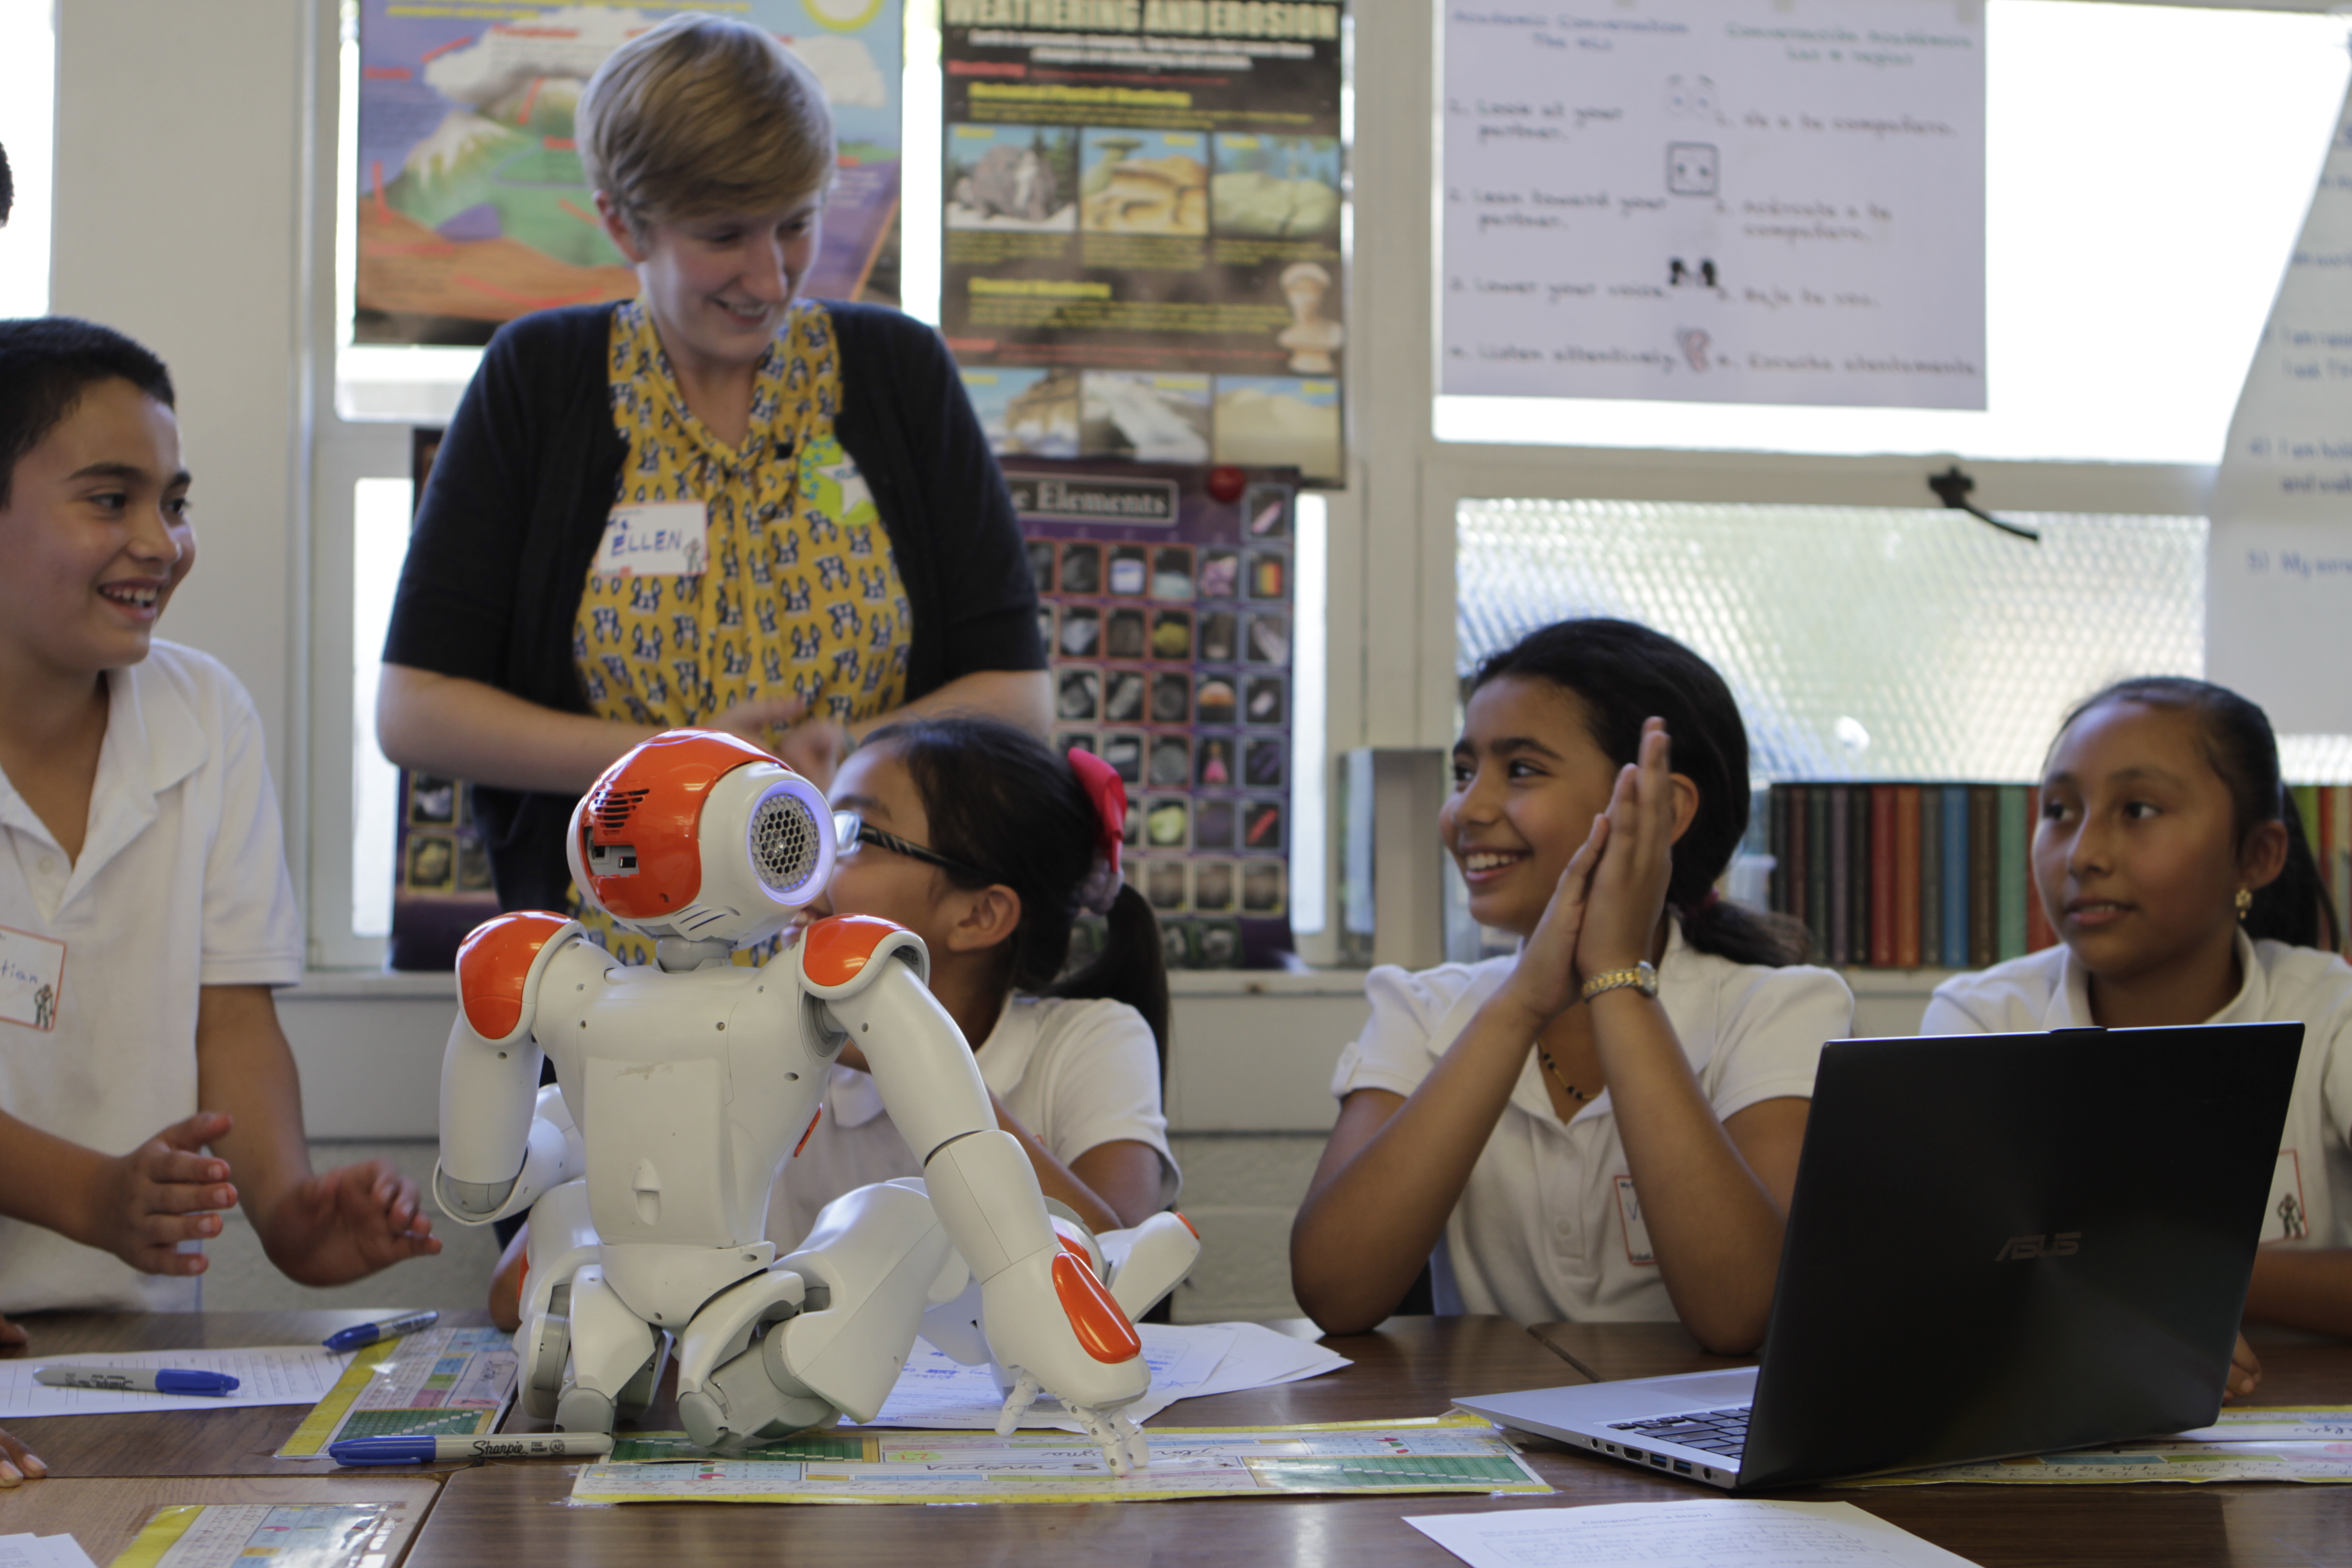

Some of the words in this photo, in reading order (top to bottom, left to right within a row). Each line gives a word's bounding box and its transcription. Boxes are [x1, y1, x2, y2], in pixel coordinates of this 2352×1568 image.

[1210, 2, 1338, 39] EROSION
[1477, 98, 1531, 115] Look
[1543, 100, 1564, 117] at
[1575, 107, 1623, 127] your
[1473, 189, 1521, 203] Lean
[1532, 190, 1609, 206] toward
[1620, 198, 1666, 220] your
[1474, 277, 1536, 293] Lower
[1548, 284, 1596, 304] your
[1477, 343, 1543, 359] Listen
[1037, 482, 1167, 515] Elements
[611, 529, 682, 557] ELLEN
[1996, 1232, 2082, 1261] ASUS
[468, 1441, 526, 1456] Sharpie
